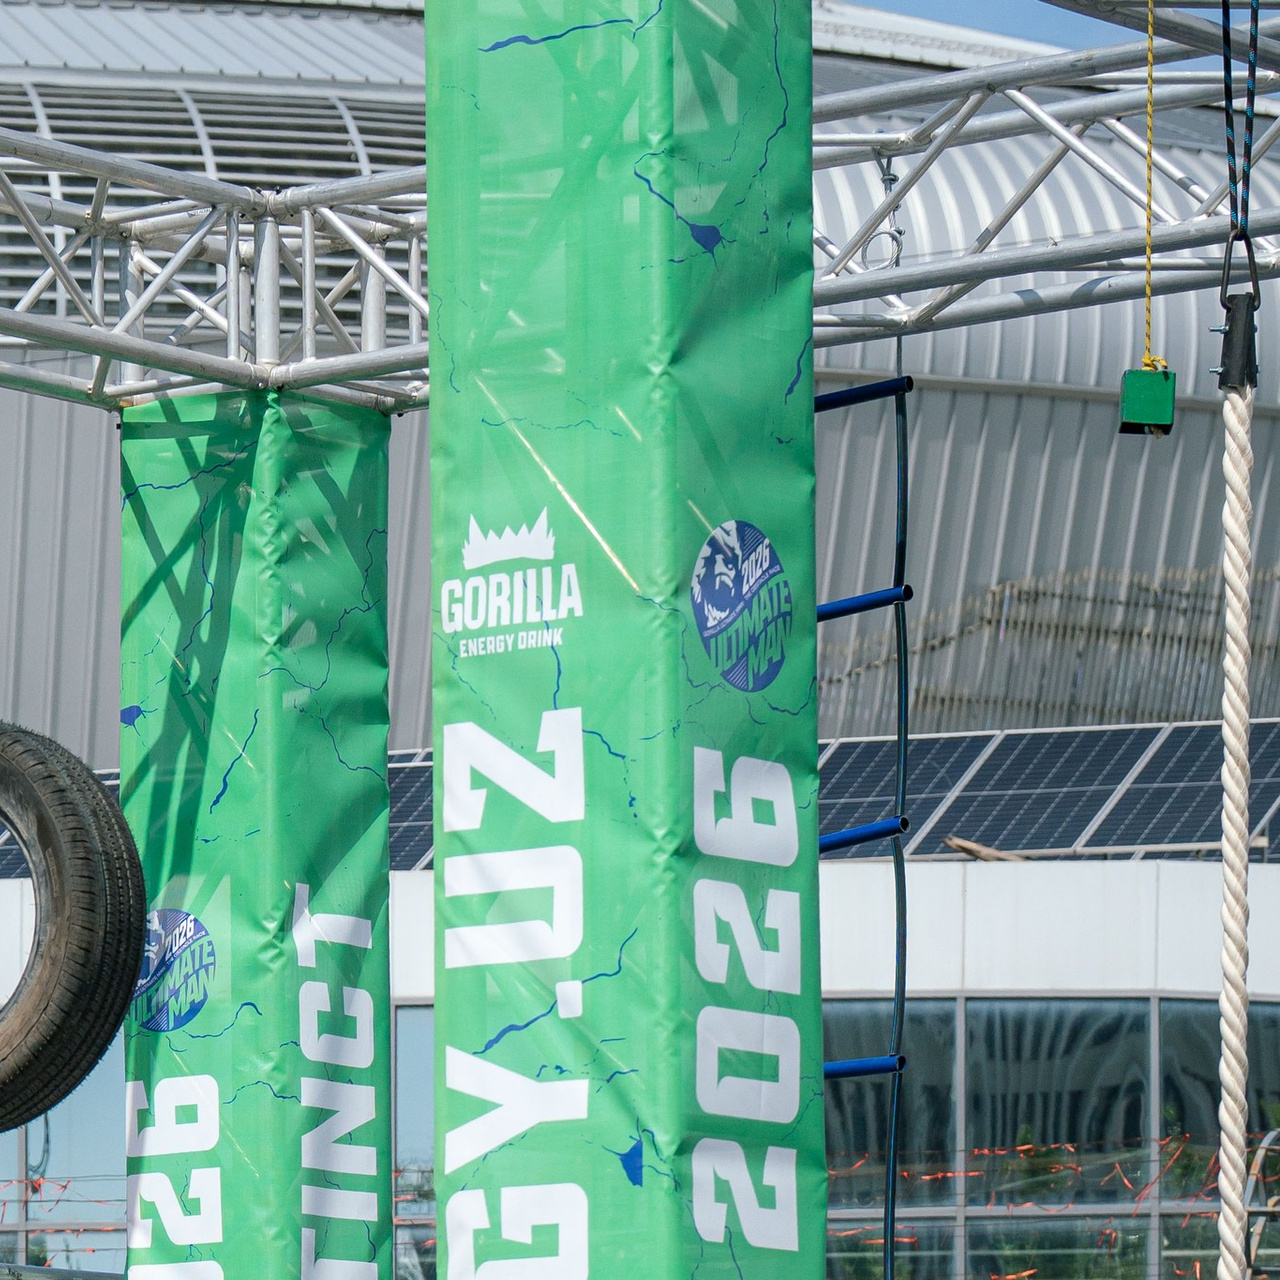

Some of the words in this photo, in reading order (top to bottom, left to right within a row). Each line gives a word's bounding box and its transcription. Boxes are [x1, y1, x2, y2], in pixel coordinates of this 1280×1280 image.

[441, 563, 584, 634] GORILLA
[742, 537, 771, 597] 2026
[459, 634, 515, 658] ENERGY
[517, 627, 563, 650] DRINK
[710, 579, 792, 672] ULTIMATE
[747, 615, 791, 691] MAN
[164, 913, 197, 960] 2026
[169, 965, 217, 1031] MAN
[691, 746, 802, 1252] 2026
